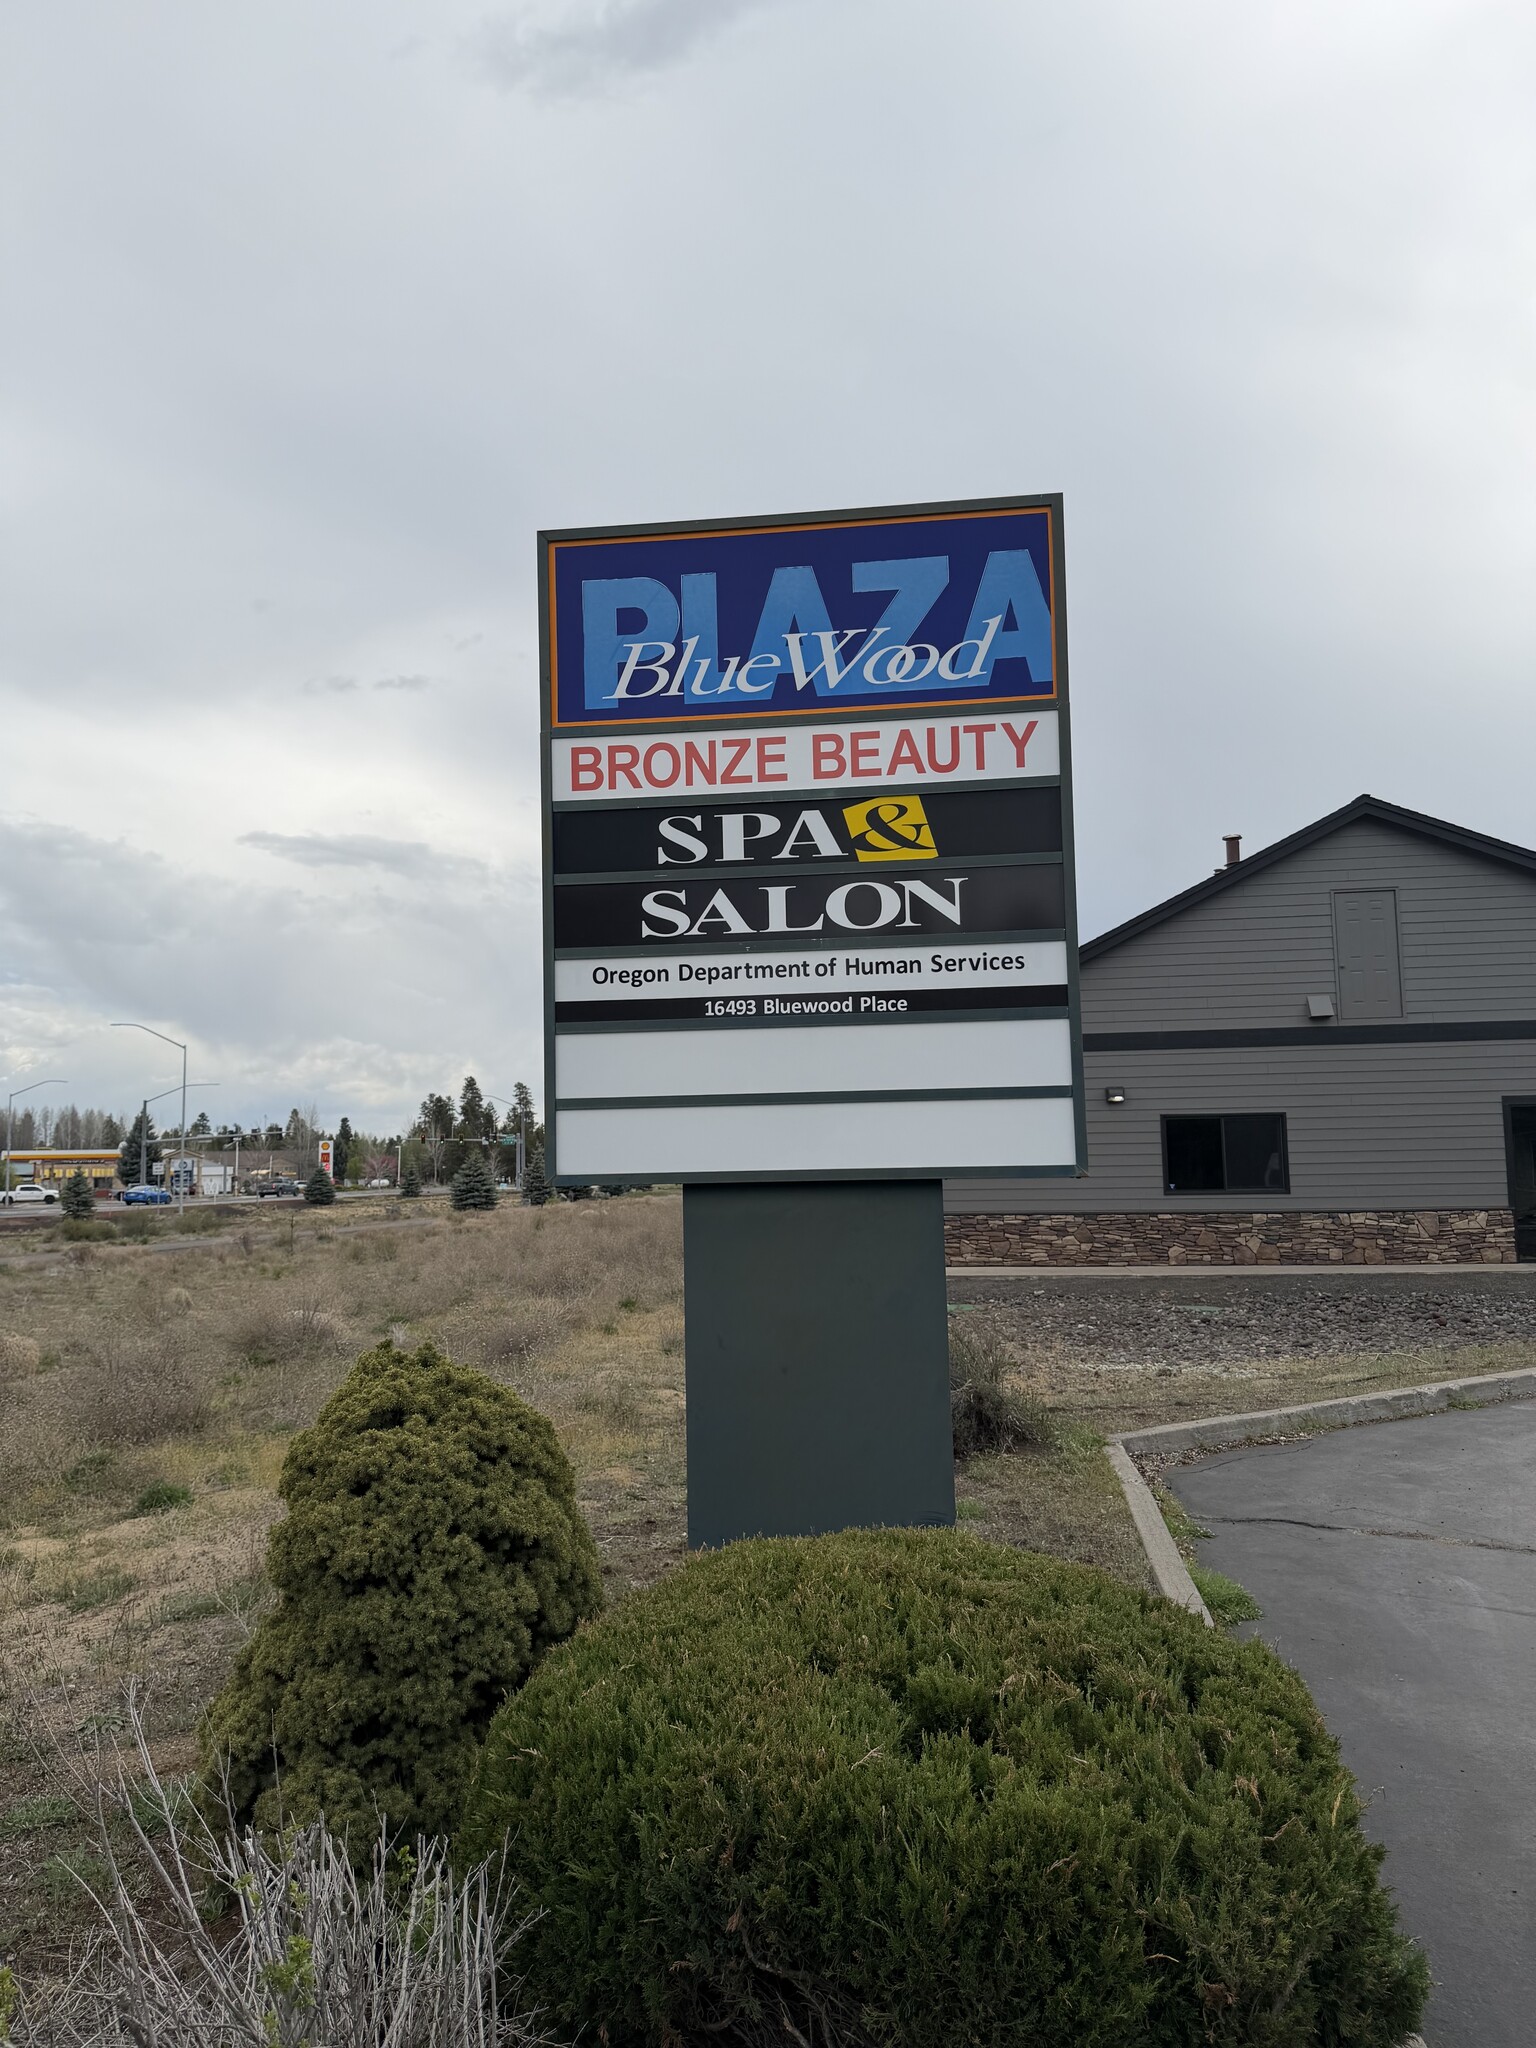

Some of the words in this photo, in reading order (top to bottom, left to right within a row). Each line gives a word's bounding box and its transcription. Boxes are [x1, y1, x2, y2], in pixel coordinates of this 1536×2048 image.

[581, 549, 1053, 710] PLAZA
[570, 736, 788, 792] BRONZE
[812, 720, 1039, 780] BEAUTY
[657, 809, 849, 865] SPA
[851, 803, 937, 852] &
[641, 877, 969, 938] SALON
[592, 965, 669, 988] Oregon
[678, 960, 810, 984] Department
[815, 957, 837, 977] of
[845, 956, 922, 976] Human
[930, 951, 1025, 973] Services
[704, 999, 757, 1017] 16493
[763, 997, 853, 1014] Bluewood
[859, 995, 908, 1012] Place
